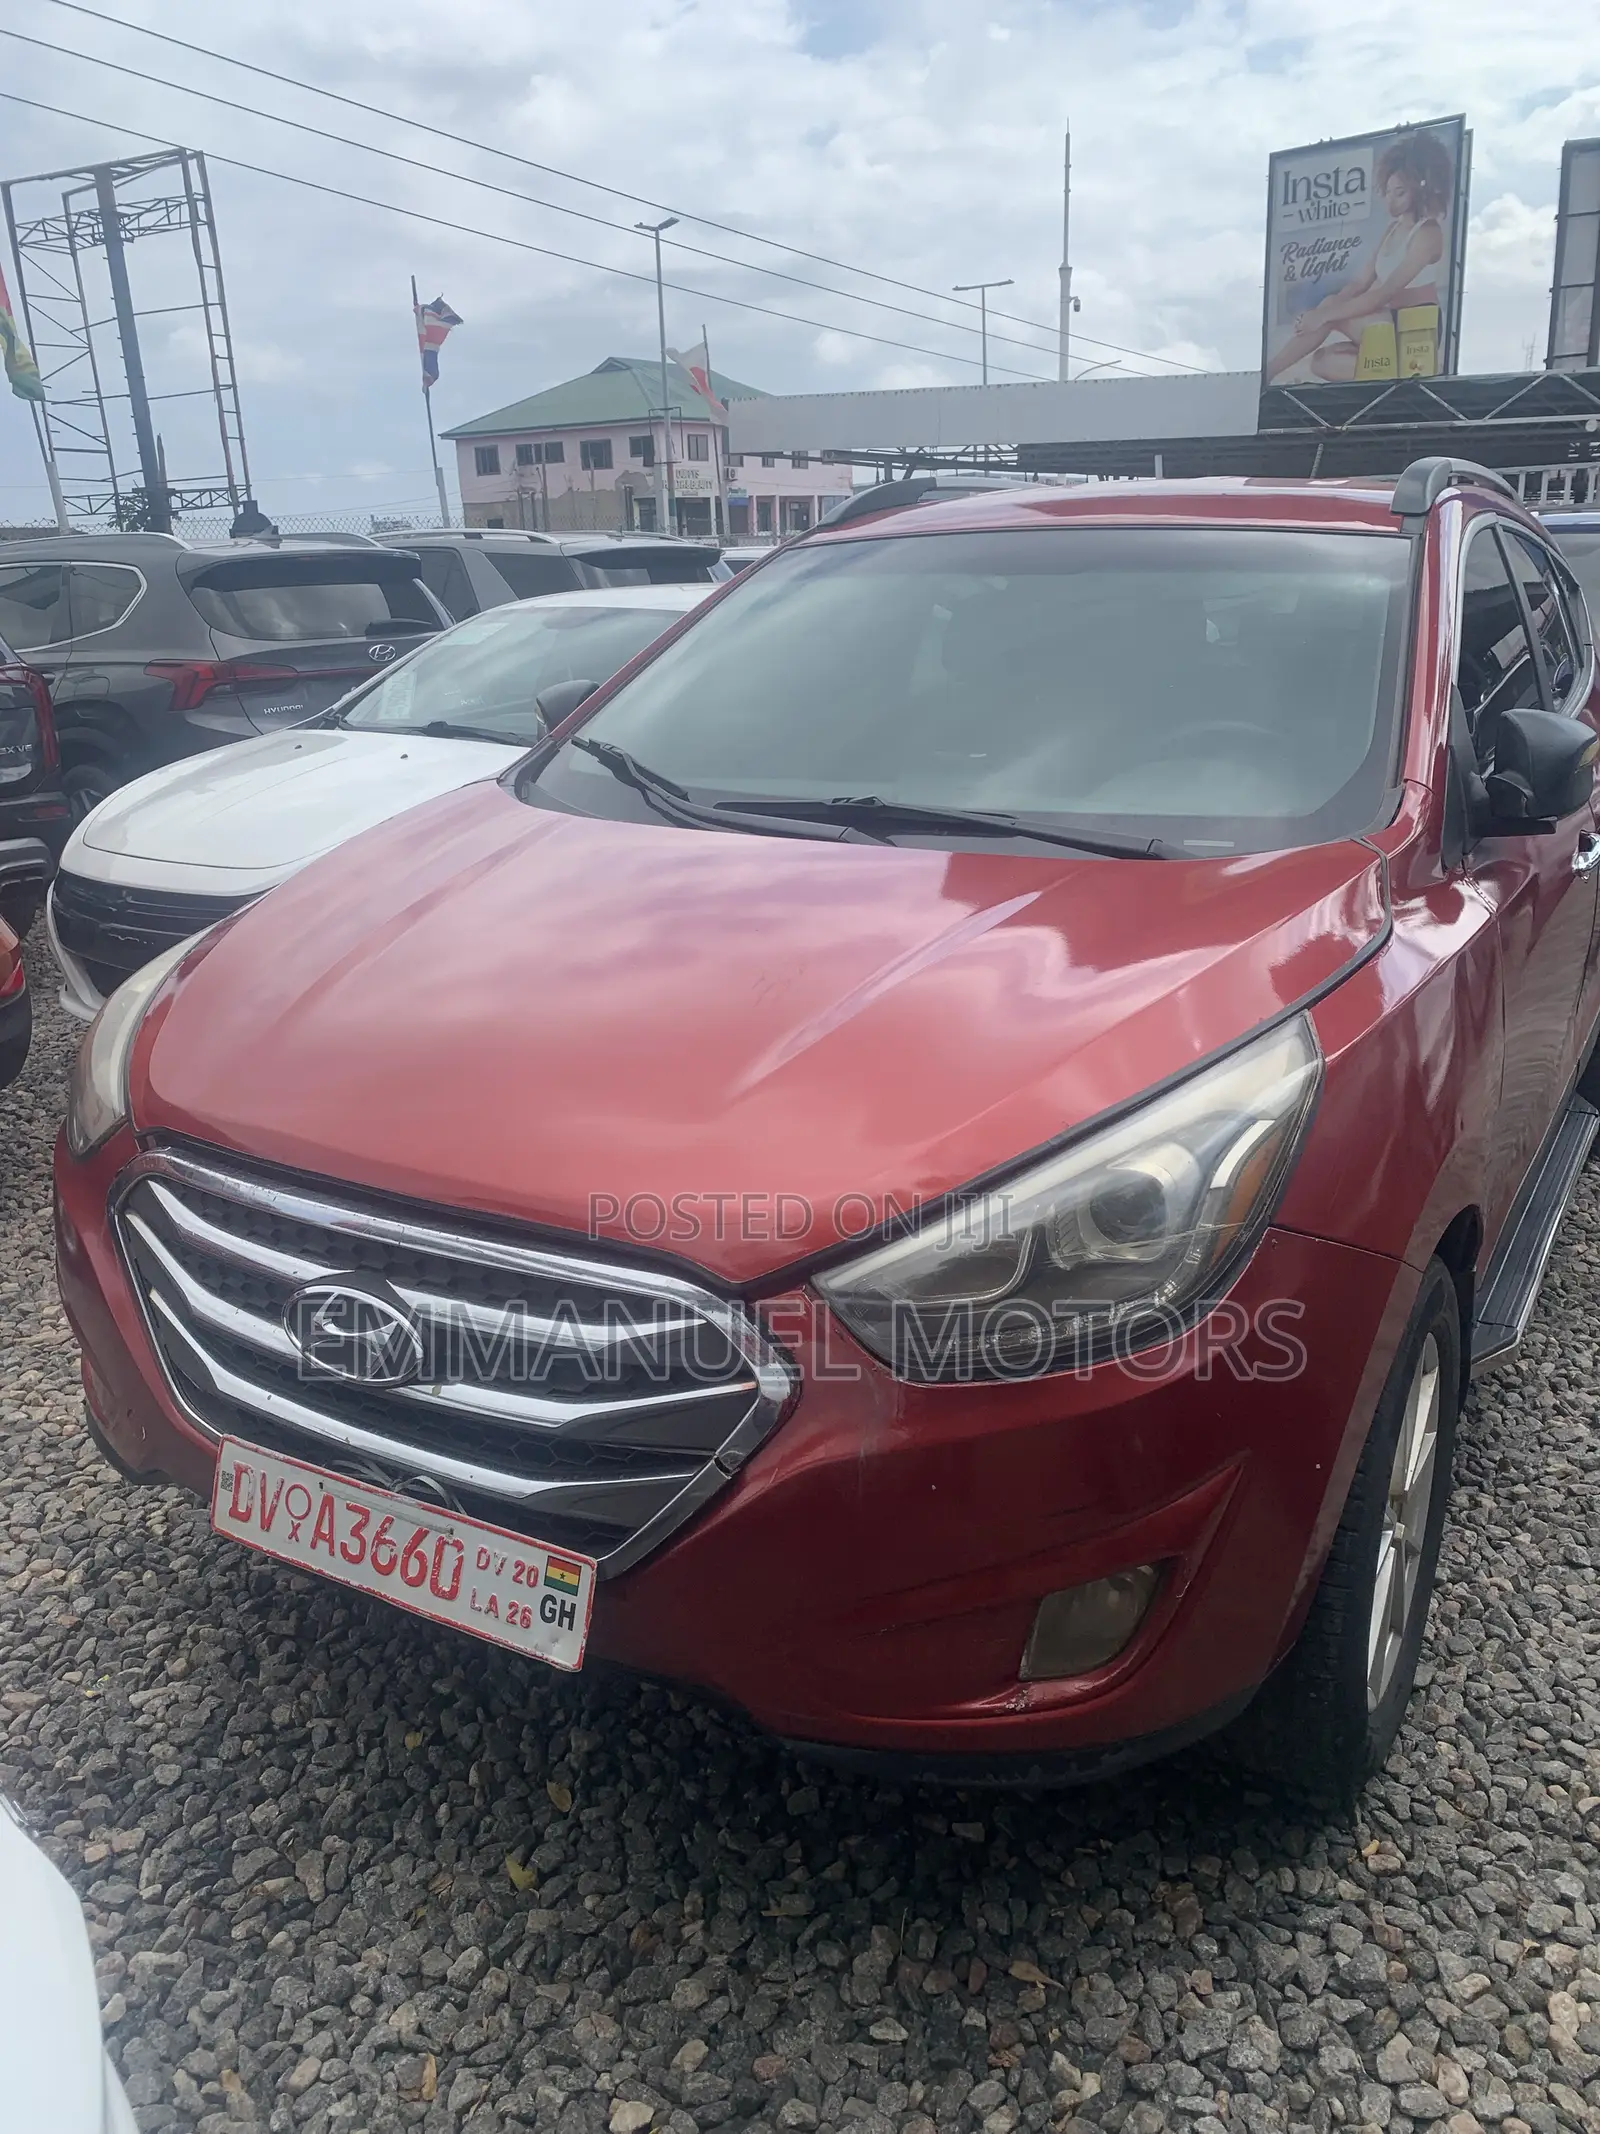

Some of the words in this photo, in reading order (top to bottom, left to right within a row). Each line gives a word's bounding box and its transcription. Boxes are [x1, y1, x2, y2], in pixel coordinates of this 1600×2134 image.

[1282, 166, 1366, 206] Insta
[1298, 199, 1350, 223] white
[1280, 235, 1363, 265] Radiance
[1284, 264, 1297, 282] &
[1300, 250, 1350, 284] light
[1363, 357, 1391, 369] Insta
[511, 1558, 539, 1588] 20
[469, 1586, 500, 1619] LA
[505, 1600, 533, 1630] 26
[540, 1593, 577, 1632] GH
